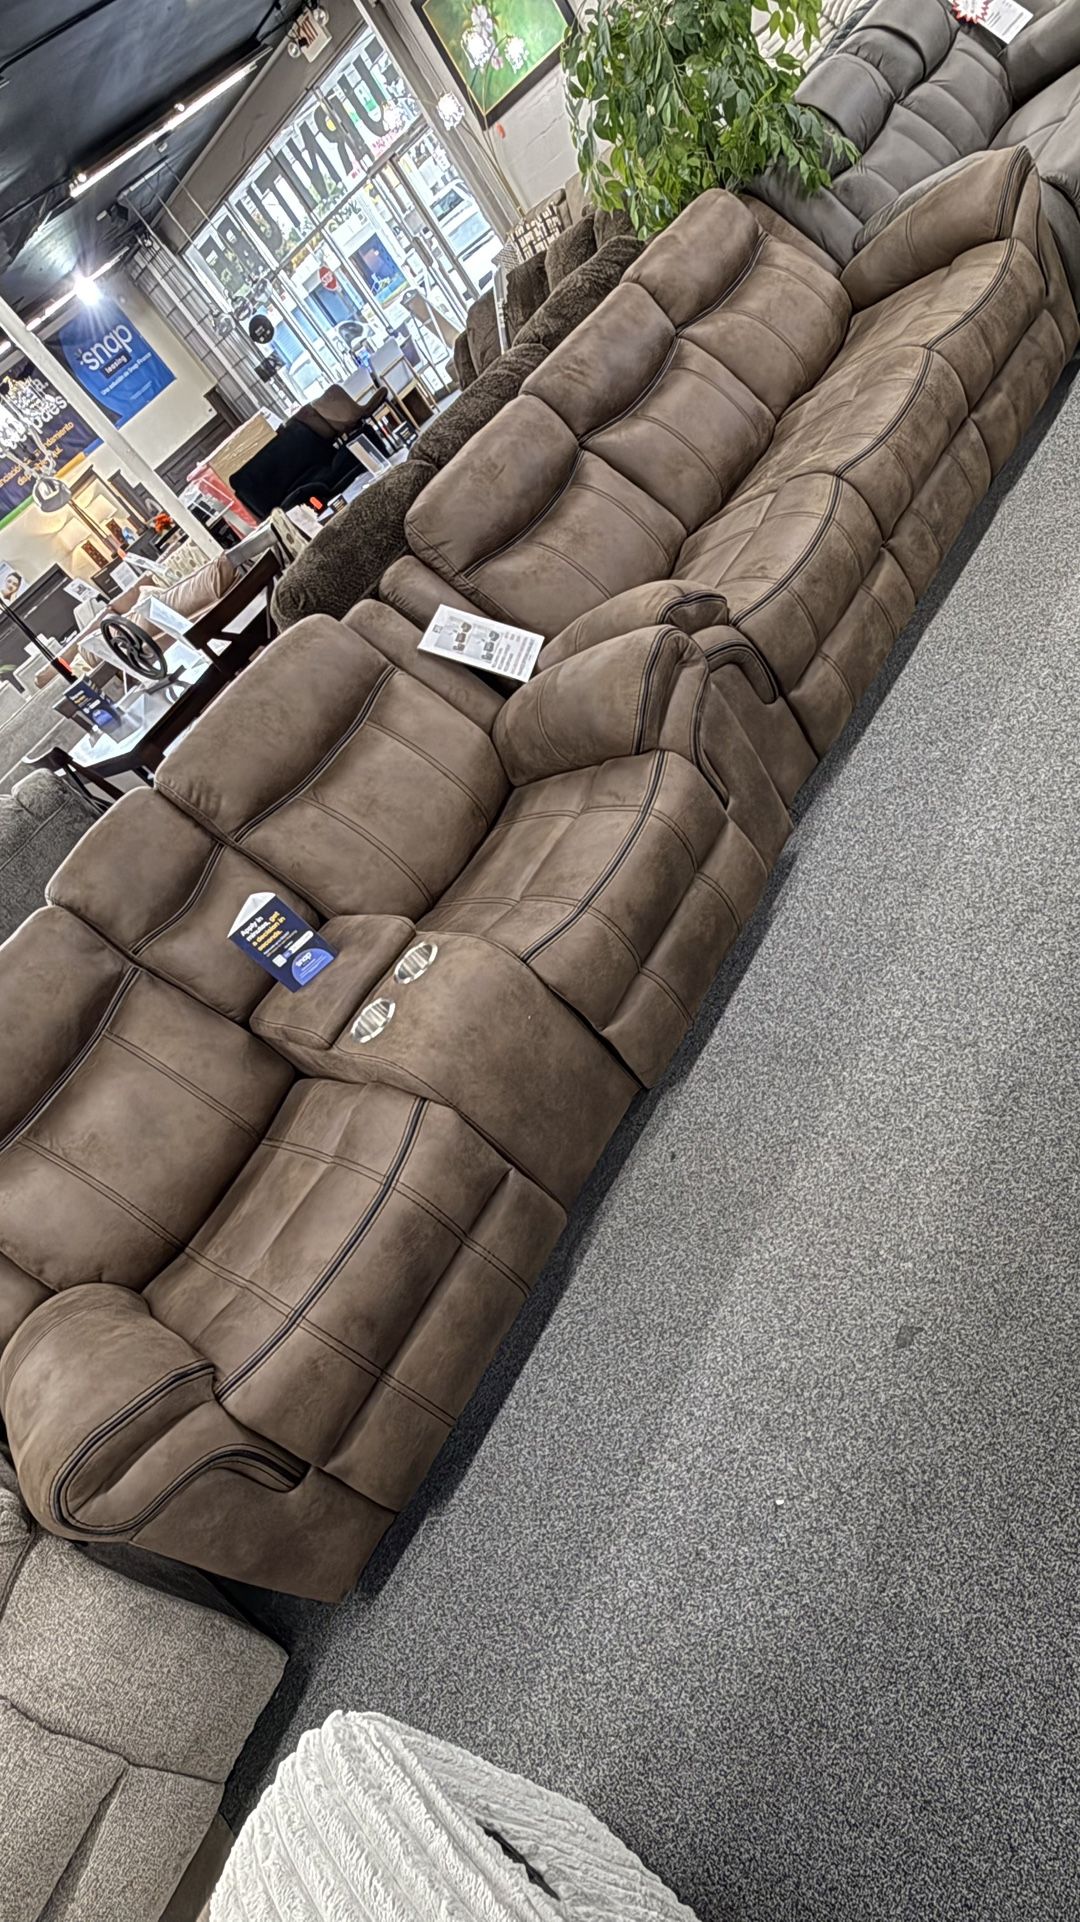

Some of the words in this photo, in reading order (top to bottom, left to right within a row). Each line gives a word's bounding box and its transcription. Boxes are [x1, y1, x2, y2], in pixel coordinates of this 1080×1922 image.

[81, 324, 133, 371] snap
[104, 355, 128, 374] leasing
[240, 921, 258, 937] Apply
[246, 921, 271, 942] minutes,
[269, 911, 280, 923] get
[256, 922, 281, 942] decision
[277, 916, 286, 924] in
[257, 930, 284, 951] seconds.
[295, 951, 313, 968] snap
